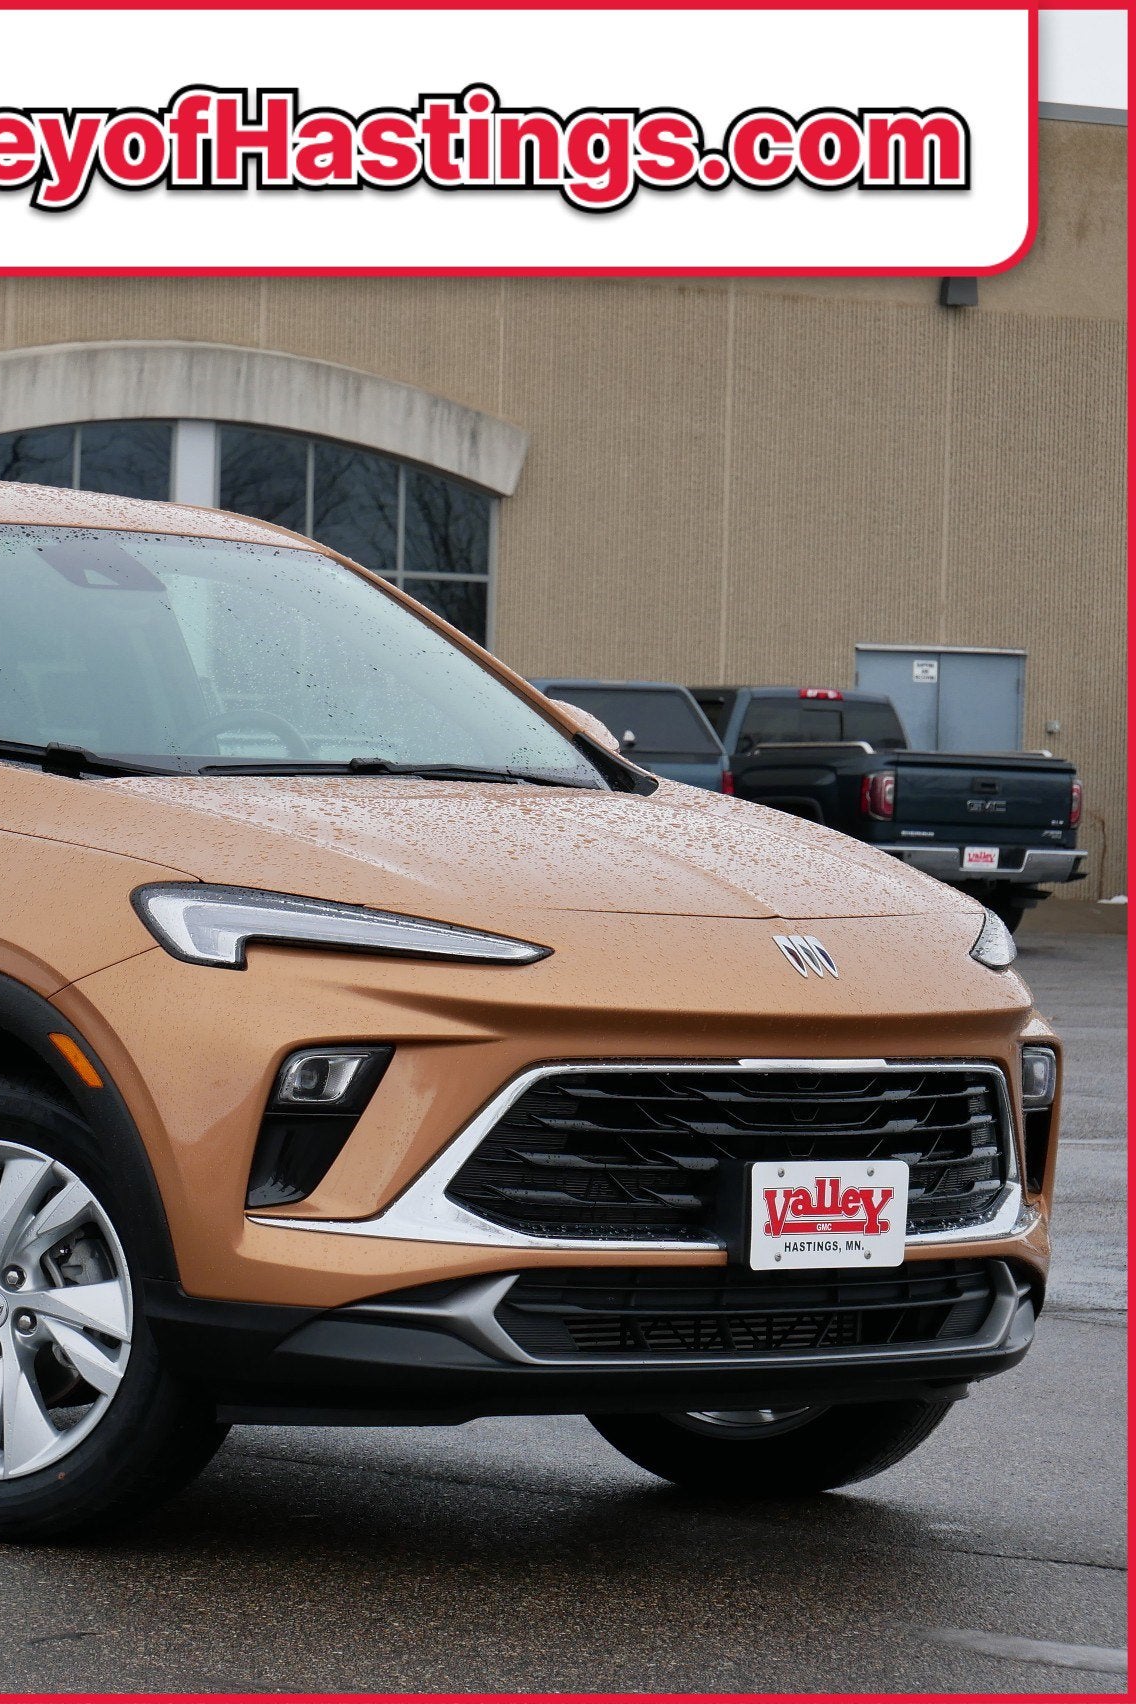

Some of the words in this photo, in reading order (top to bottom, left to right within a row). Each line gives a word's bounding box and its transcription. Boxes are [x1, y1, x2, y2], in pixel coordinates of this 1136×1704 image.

[816, 1222, 833, 1232] GMC
[784, 1240, 842, 1254] HASTINGS,
[845, 1240, 865, 1251] MN.
